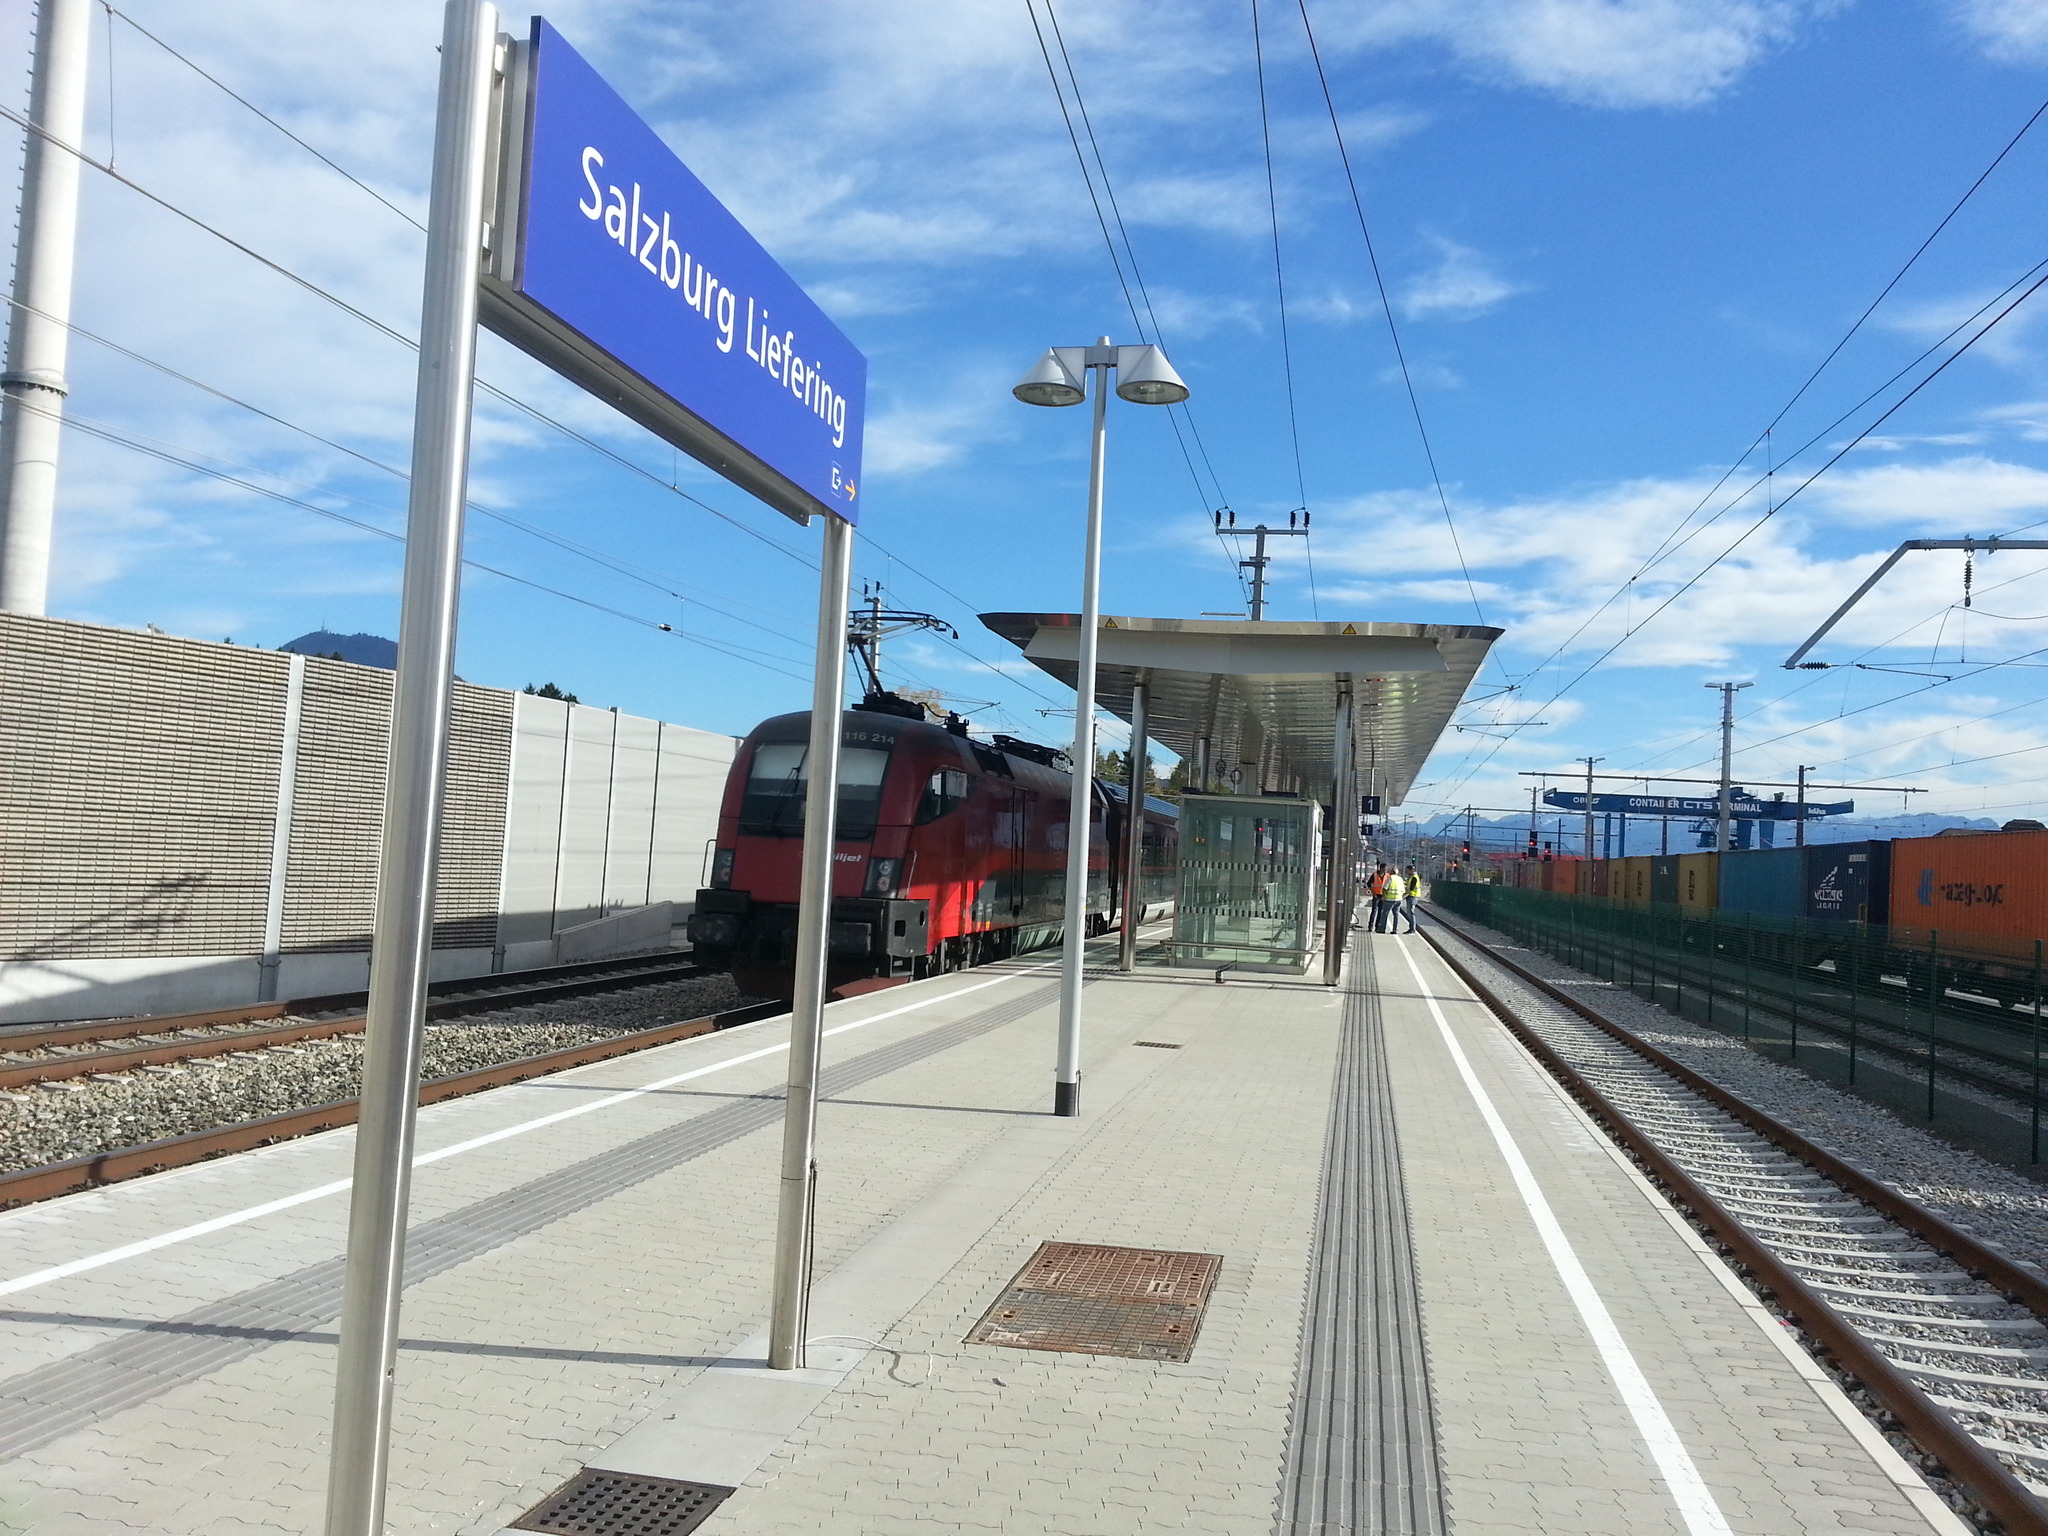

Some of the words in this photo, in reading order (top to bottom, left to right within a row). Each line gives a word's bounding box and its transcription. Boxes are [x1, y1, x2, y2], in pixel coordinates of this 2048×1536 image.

[579, 146, 735, 354] Salzburg
[746, 296, 846, 448] Liefering
[871, 733, 896, 745] 214
[1367, 799, 1374, 811] 1
[1683, 800, 1713, 810] CTS
[1716, 802, 1762, 812] TRMINAL
